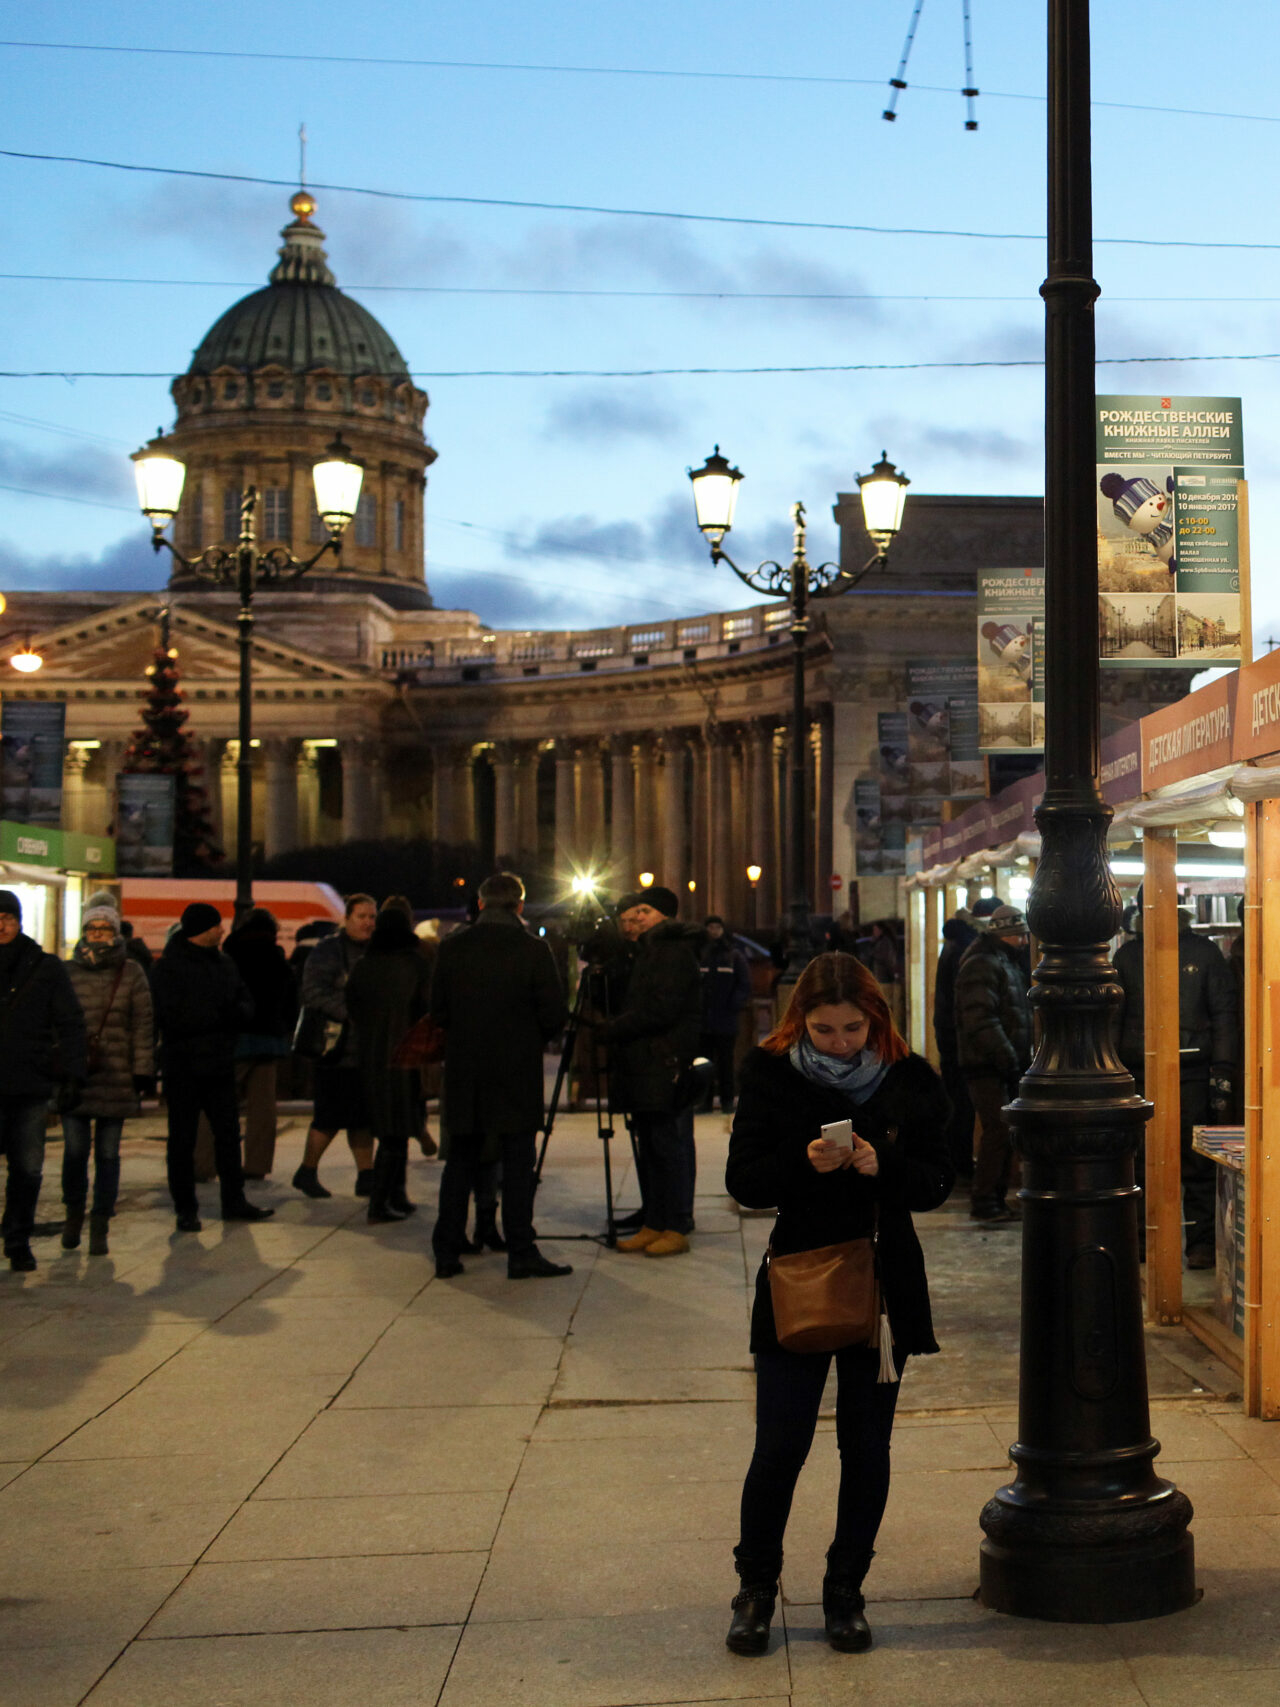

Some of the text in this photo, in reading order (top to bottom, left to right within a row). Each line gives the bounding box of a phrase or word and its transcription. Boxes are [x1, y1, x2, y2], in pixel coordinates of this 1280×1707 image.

[1100, 410, 1234, 424] РОЖДЕСТВЕНСКИЕ
[1104, 424, 1230, 438] КНИЖНЫЕ АЛЛЕИ
[1151, 452, 1192, 460] ЧИТАЮЩИЙ
[1193, 452, 1232, 460] ПЕТЕРБУРГ!
[1188, 493, 1220, 502] декабря
[1178, 502, 1236, 512] 10 января 2017
[1192, 526, 1216, 535] 22-00
[982, 578, 1045, 587] РОЖДЕСТВЕ
[984, 588, 1036, 597] КНИЖНЫЕ
[1148, 727, 1182, 774] ДЕТСКАЯ
[1182, 704, 1232, 755] ЛИТЕРАТУРА
